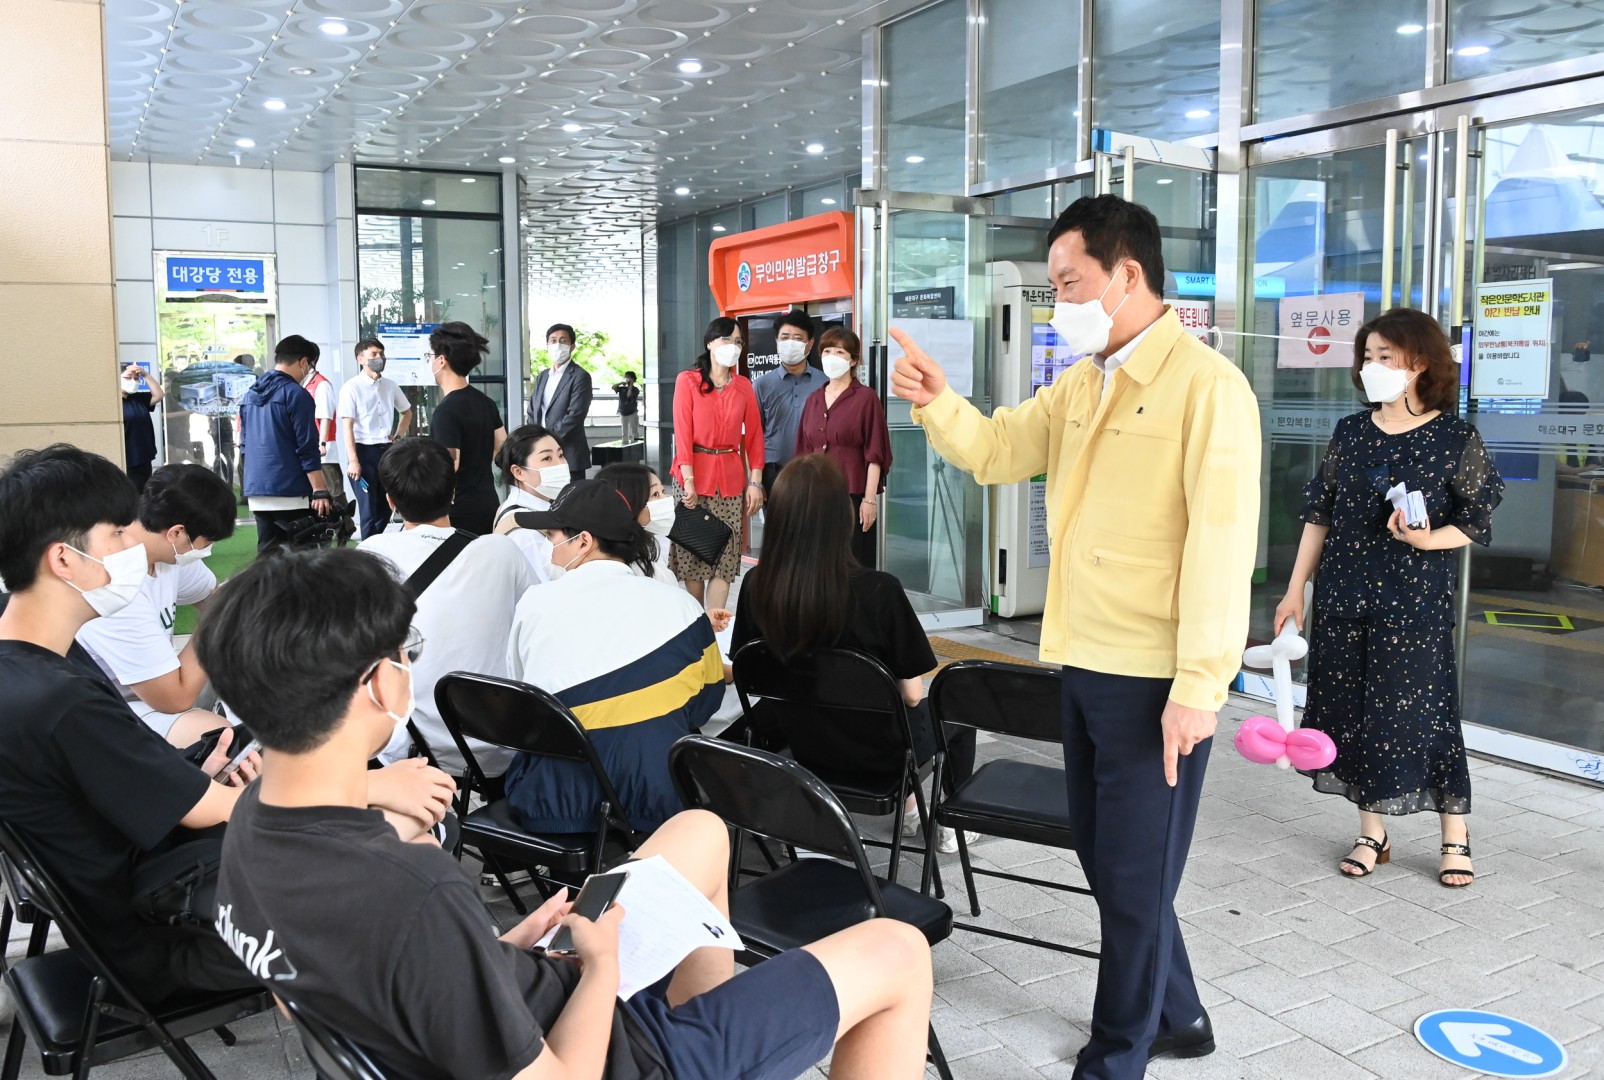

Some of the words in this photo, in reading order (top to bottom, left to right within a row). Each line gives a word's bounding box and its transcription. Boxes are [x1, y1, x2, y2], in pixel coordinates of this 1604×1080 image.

[201, 223, 229, 247] 1F
[755, 249, 841, 284] 무인민원발급창구
[172, 266, 222, 284] 대강당
[227, 267, 259, 285] 전용
[1185, 275, 1210, 285] SMART
[1022, 289, 1056, 302] 해운대구
[1480, 291, 1545, 305] 작은인문학도서관
[1290, 309, 1351, 328] 옆문사용
[1484, 307, 1501, 318] 야간
[1504, 306, 1520, 317] 반납
[1523, 305, 1541, 316] 안내
[1538, 424, 1577, 436] 해운대구
